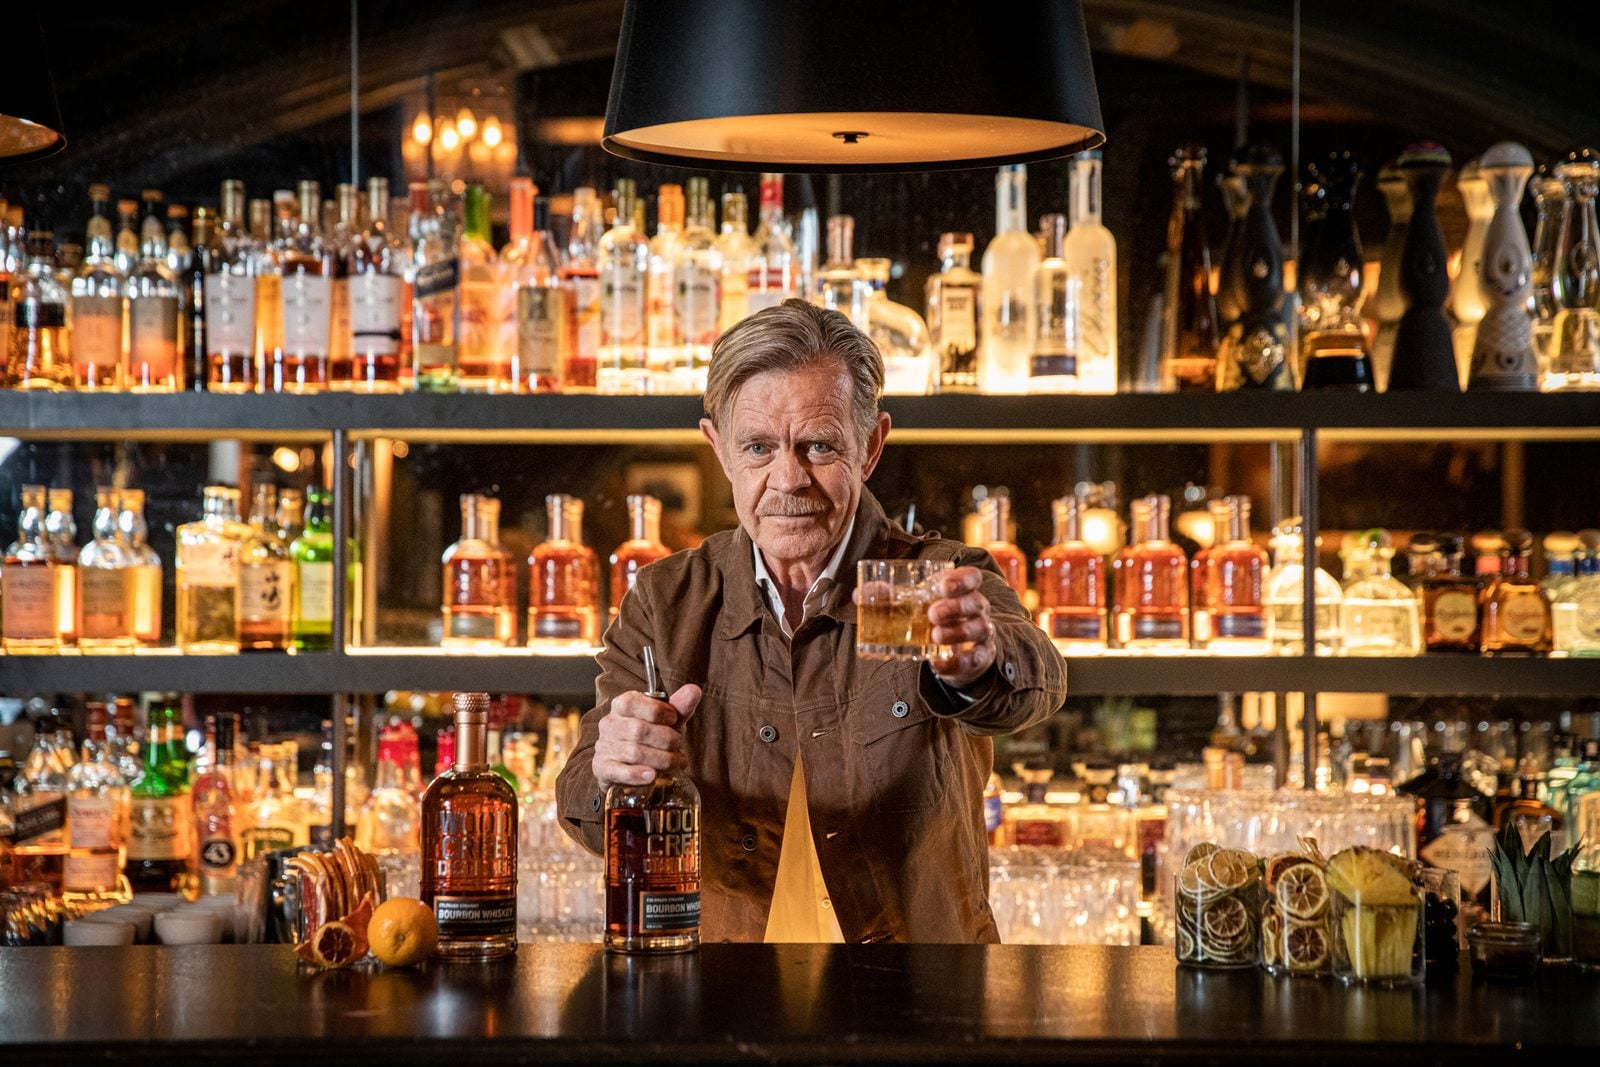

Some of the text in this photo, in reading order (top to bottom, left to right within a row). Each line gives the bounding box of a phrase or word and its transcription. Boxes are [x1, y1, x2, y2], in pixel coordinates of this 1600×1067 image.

[438, 907, 513, 919] BOURBON WHISKEY
[646, 903, 685, 914] BOURBON
